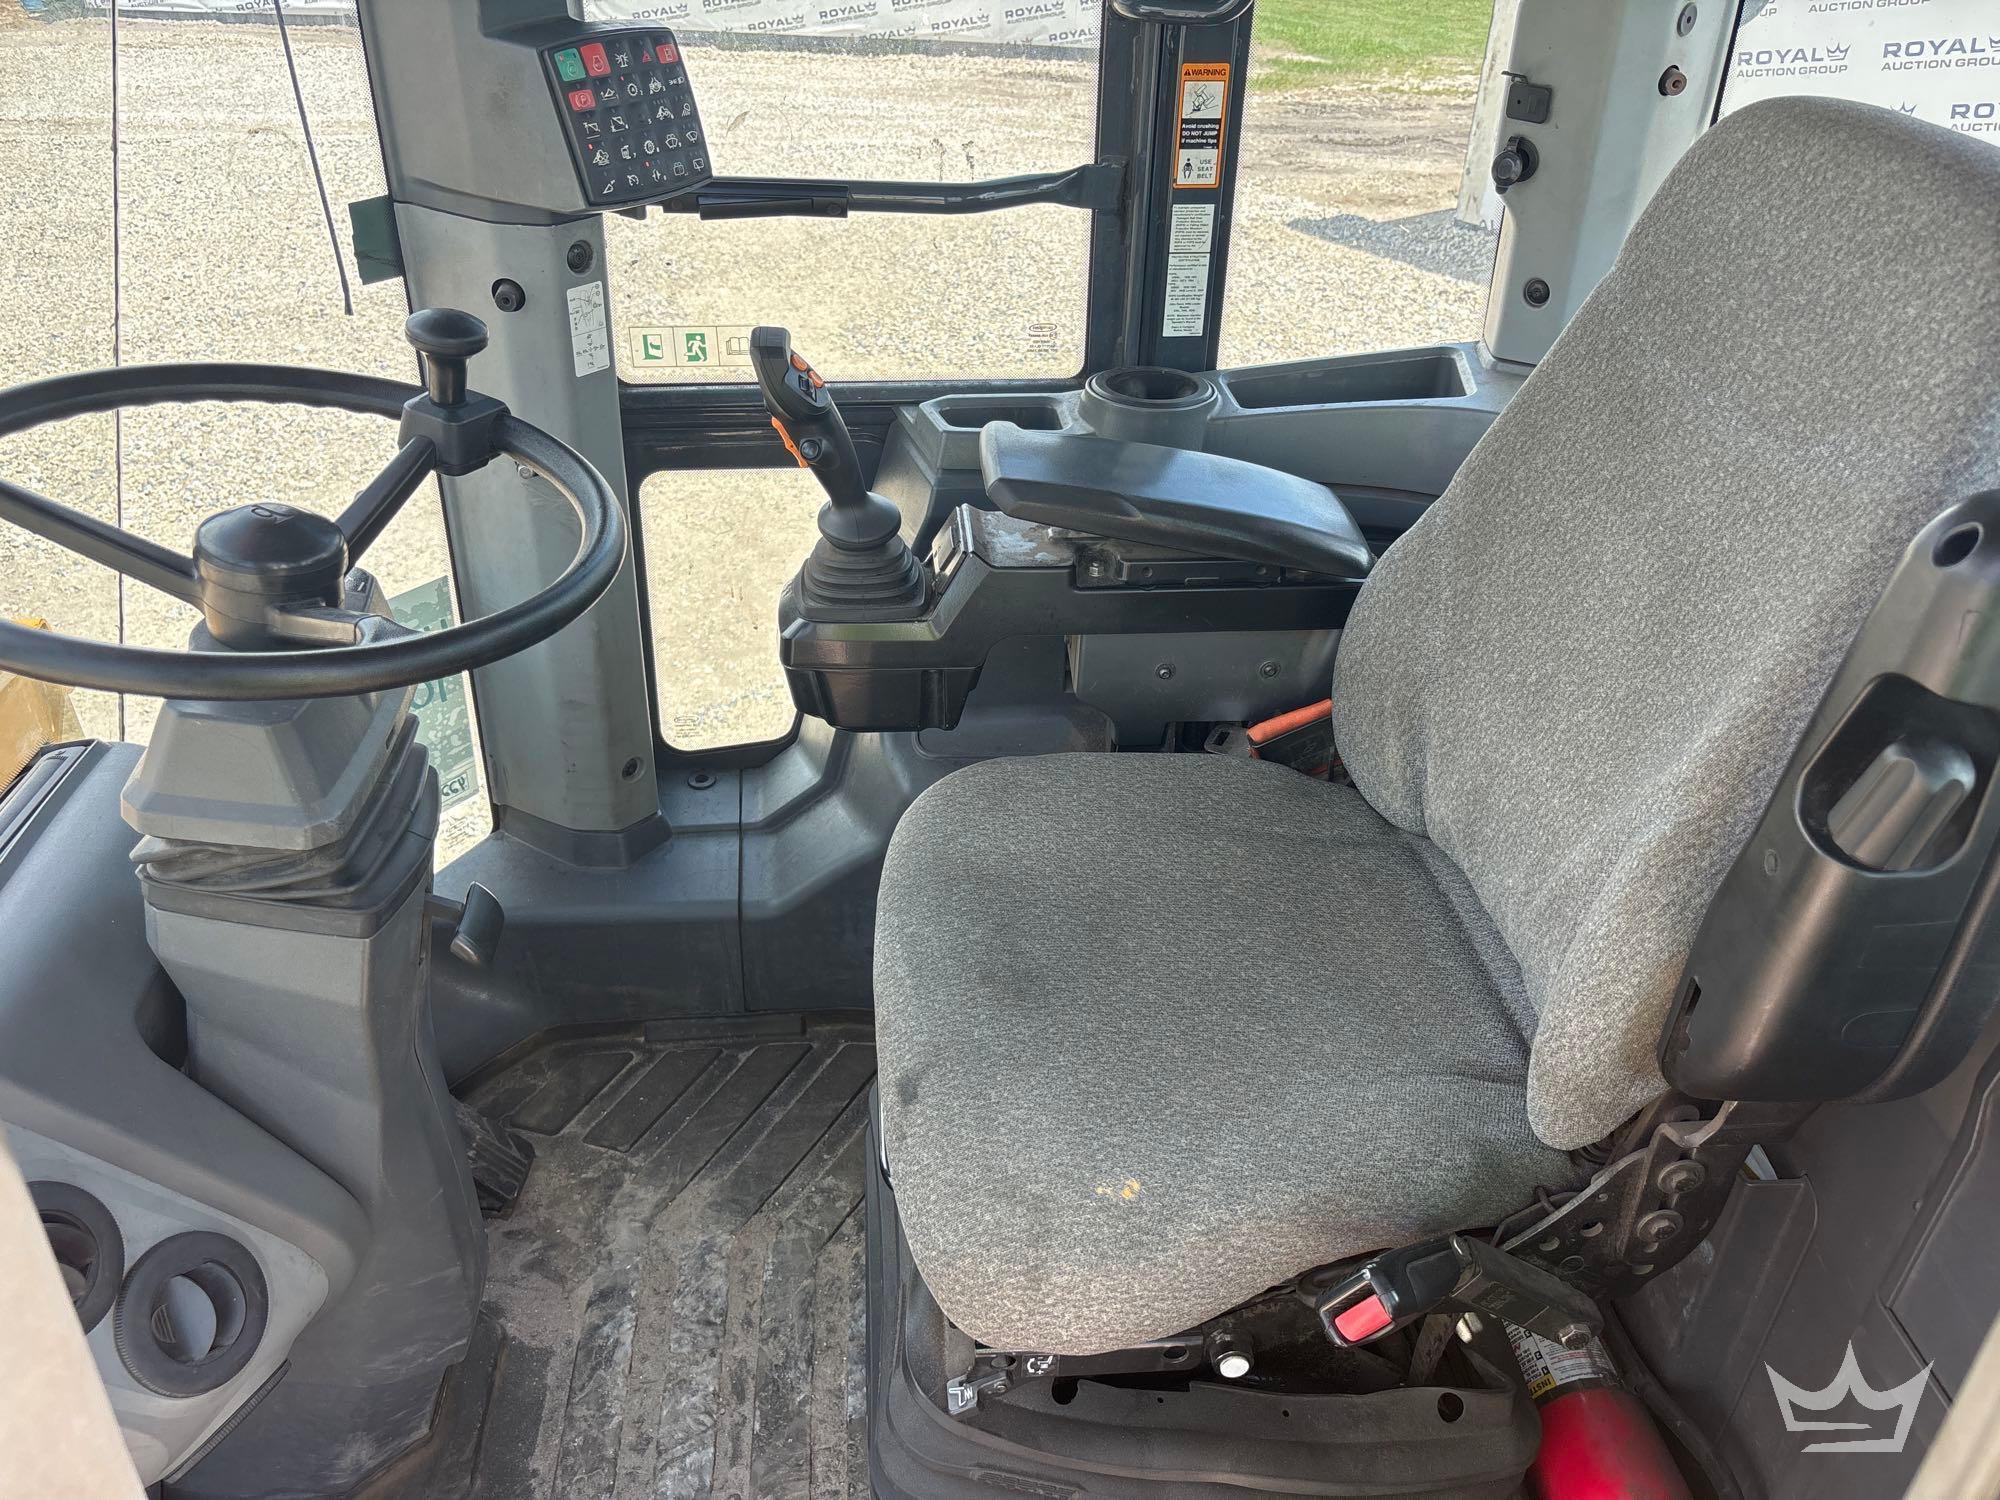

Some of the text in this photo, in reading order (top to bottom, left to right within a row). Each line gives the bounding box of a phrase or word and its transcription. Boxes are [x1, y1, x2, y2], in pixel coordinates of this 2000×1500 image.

[236, 0, 275, 11] ROYA
[820, 5, 865, 19] ROYAL
[1005, 4, 1052, 19] ROYAL
[1808, 1, 1873, 13] AUCTION
[632, 6, 677, 19] ROYAL
[748, 17, 793, 31] ROYAL
[821, 16, 853, 25] AUCTION
[931, 17, 978, 31] ROYAL
[1007, 15, 1039, 24] AUCTION
[1049, 28, 1096, 42] ROYAL
[1883, 37, 1986, 58] ROYAL
[1738, 48, 1824, 66] ROYAL
[1881, 57, 2000, 71] AUCTION GROU
[1191, 68, 1226, 76] WARNING
[1737, 65, 1848, 78] AUCTION GROUP
[1951, 122, 2000, 132] AUCTI
